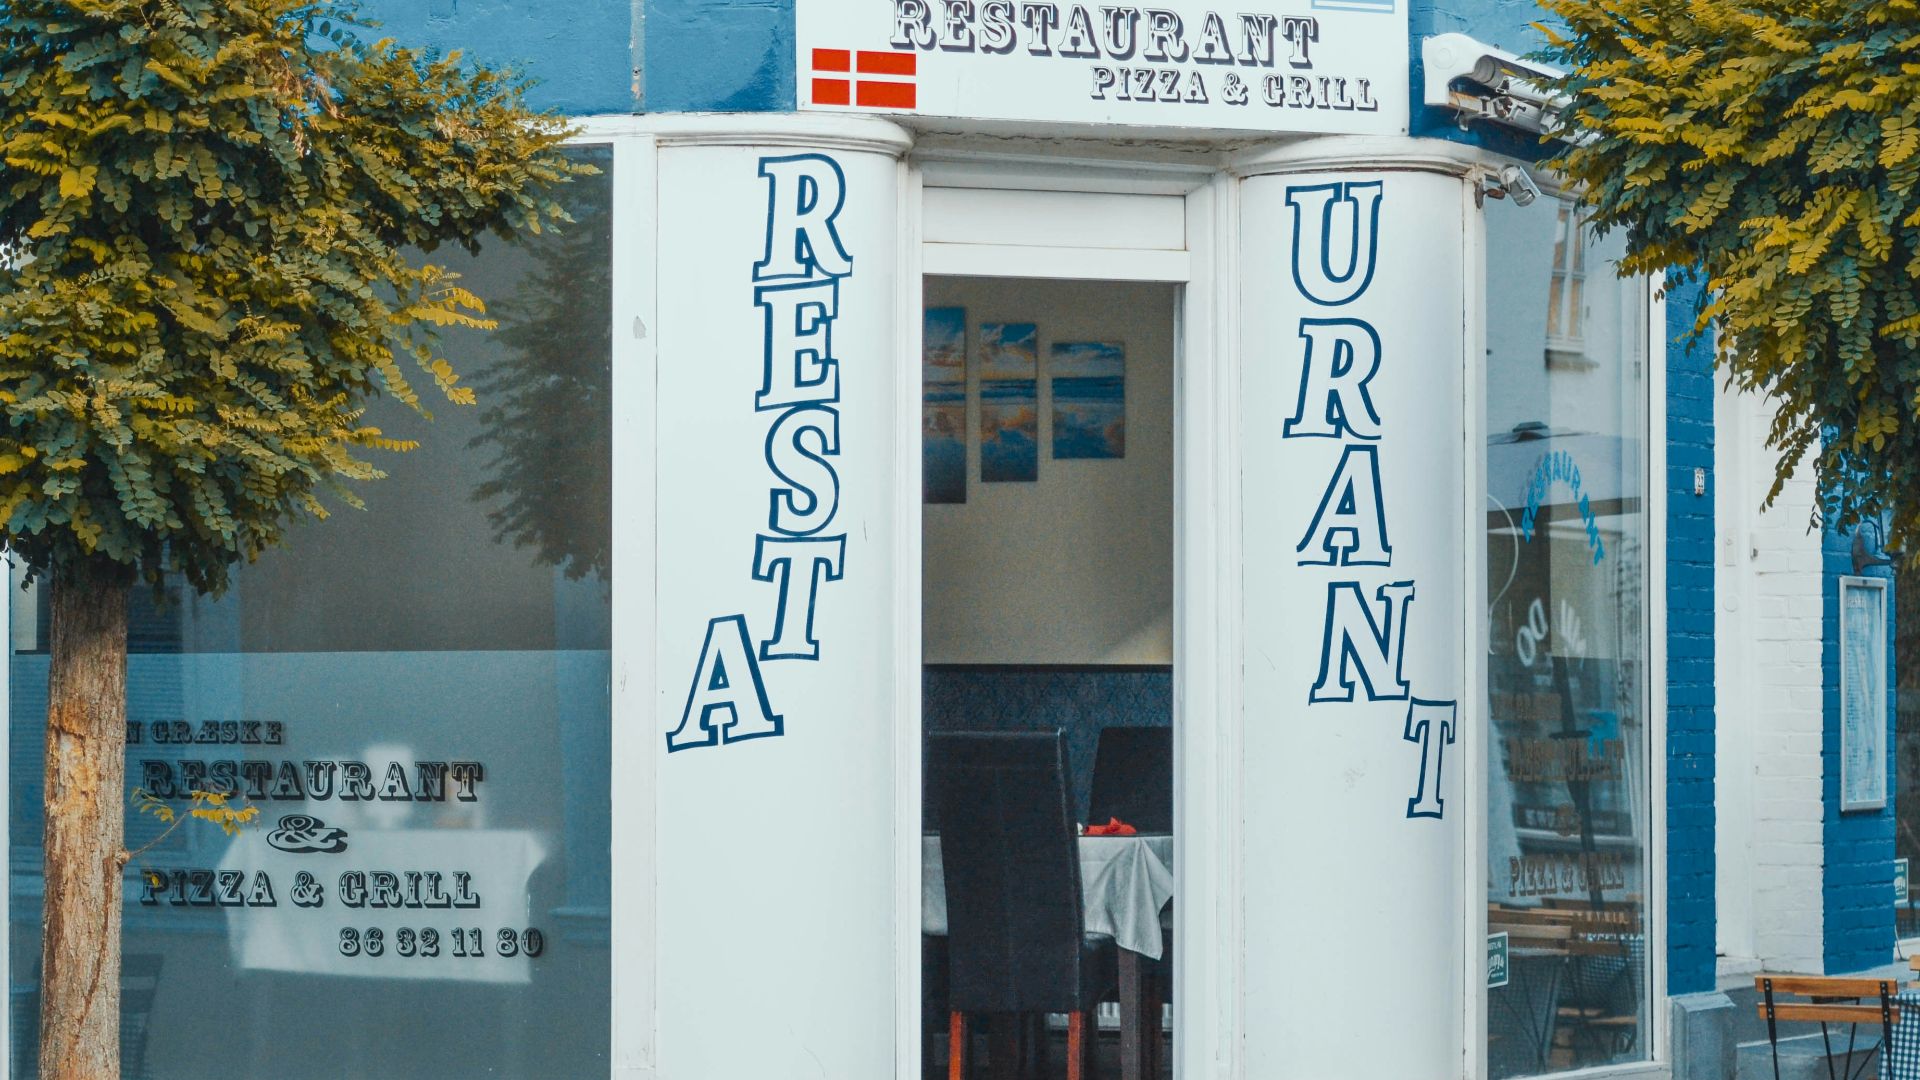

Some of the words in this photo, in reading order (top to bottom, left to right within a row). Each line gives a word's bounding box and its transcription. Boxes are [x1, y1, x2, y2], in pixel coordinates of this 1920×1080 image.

[889, 0, 1319, 69] RESTAURANT
[1090, 65, 1209, 104] PIZZA
[1221, 72, 1248, 105] &
[1261, 72, 1378, 112] GRILL
[151, 720, 283, 745] GRÆSKE
[140, 759, 484, 802] RESTAURANT
[266, 814, 348, 853] &
[140, 868, 277, 908] PIZZA
[290, 870, 324, 908] &
[338, 870, 481, 909] GRILL
[338, 926, 385, 958] 86
[395, 926, 440, 958] 32
[450, 926, 485, 958] 11
[496, 926, 545, 958] 80
